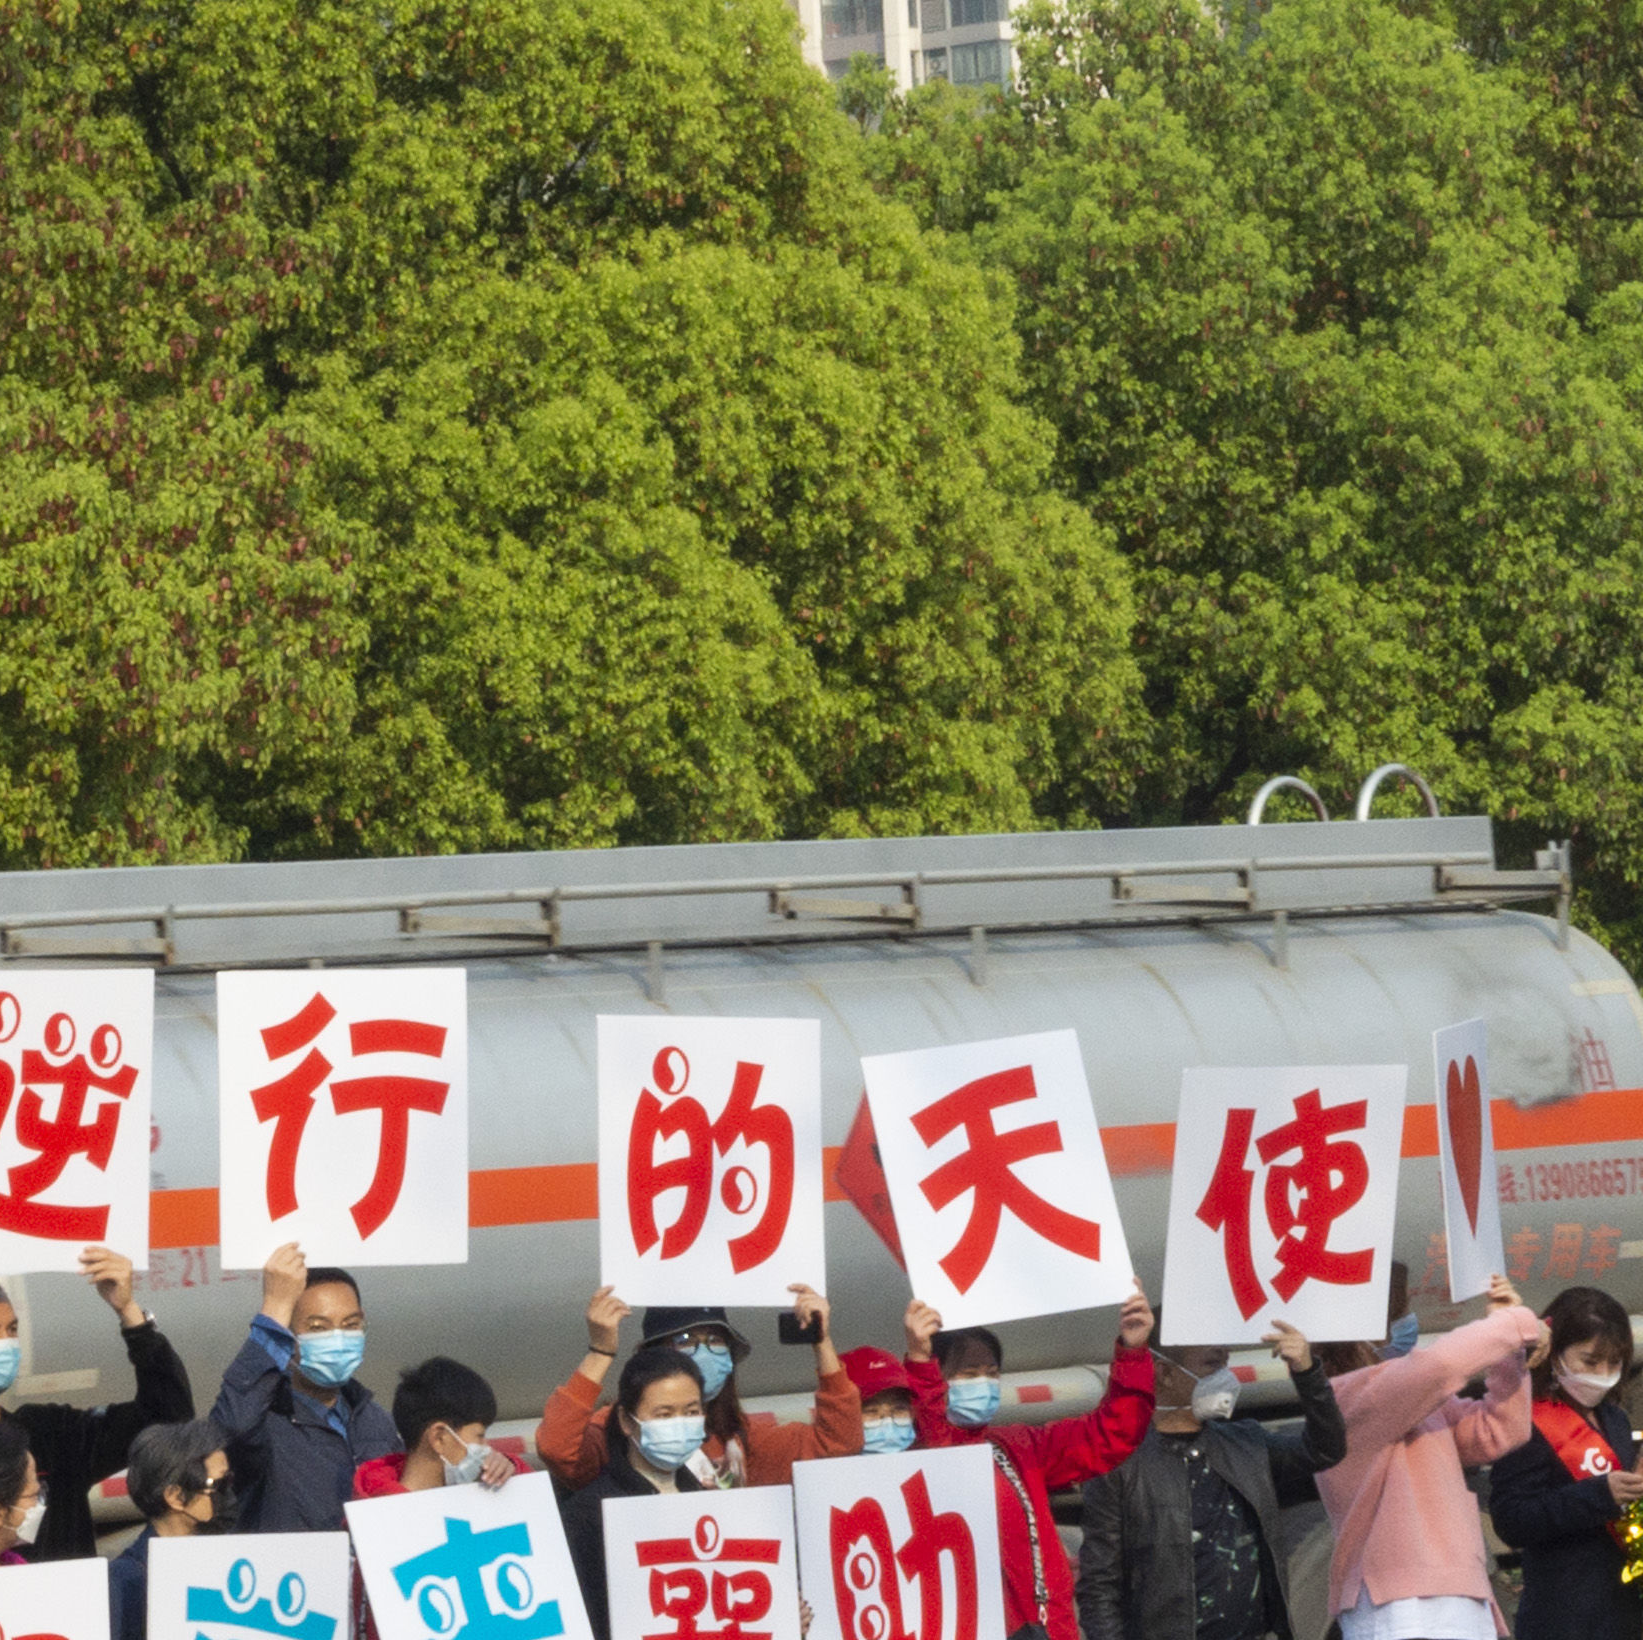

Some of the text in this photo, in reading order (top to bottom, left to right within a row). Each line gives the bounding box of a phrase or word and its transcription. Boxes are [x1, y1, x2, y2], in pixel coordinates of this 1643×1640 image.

[251, 994, 448, 1238] 行
[628, 1047, 794, 1273] 的
[912, 1066, 1099, 1293] 天
[1197, 1090, 1373, 1319] 使
